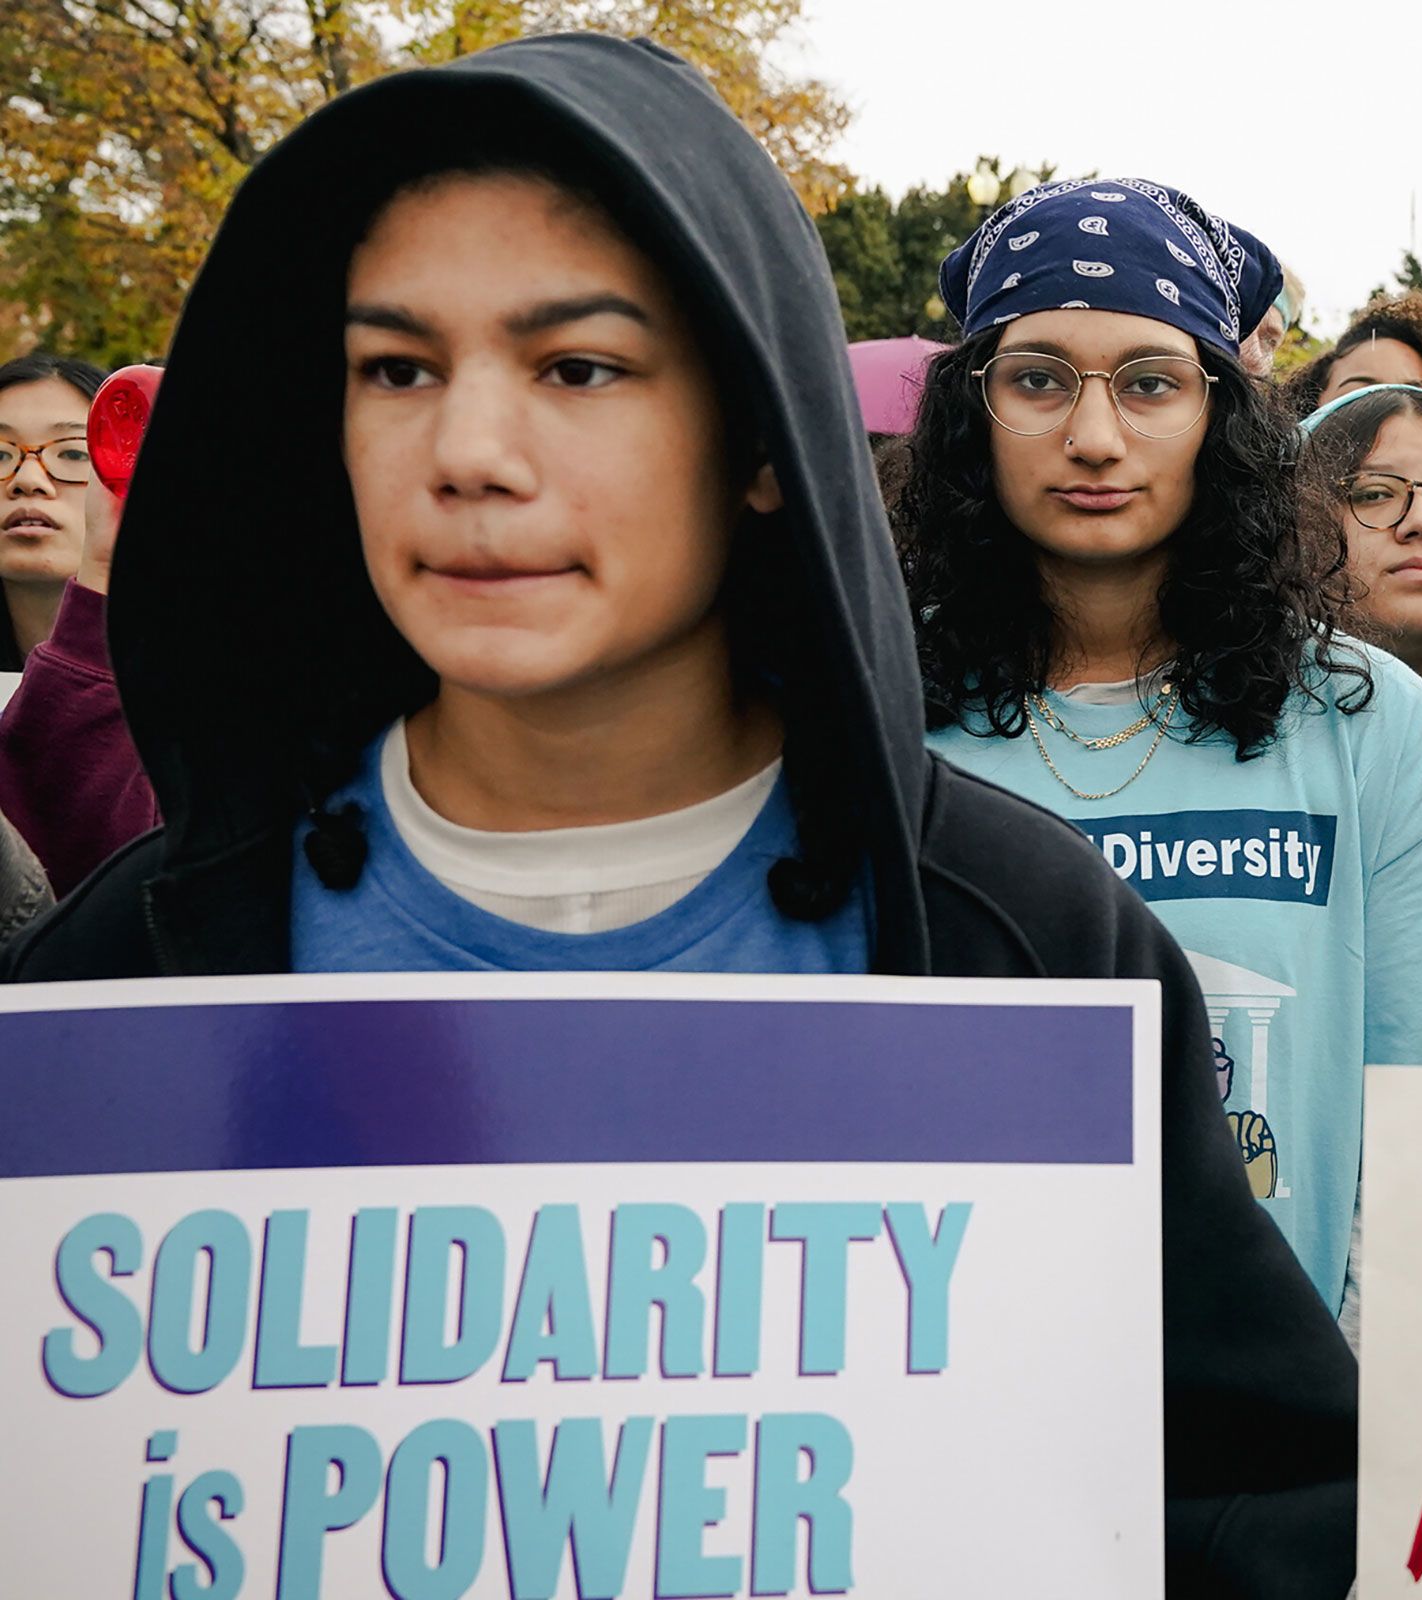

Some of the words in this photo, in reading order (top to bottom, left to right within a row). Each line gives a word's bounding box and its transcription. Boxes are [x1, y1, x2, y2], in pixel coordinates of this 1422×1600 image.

[1086, 828, 1322, 896] Diversity
[42, 1201, 974, 1400] SOLIDARITY
[132, 1430, 246, 1600] is
[275, 1412, 856, 1600] POWER
